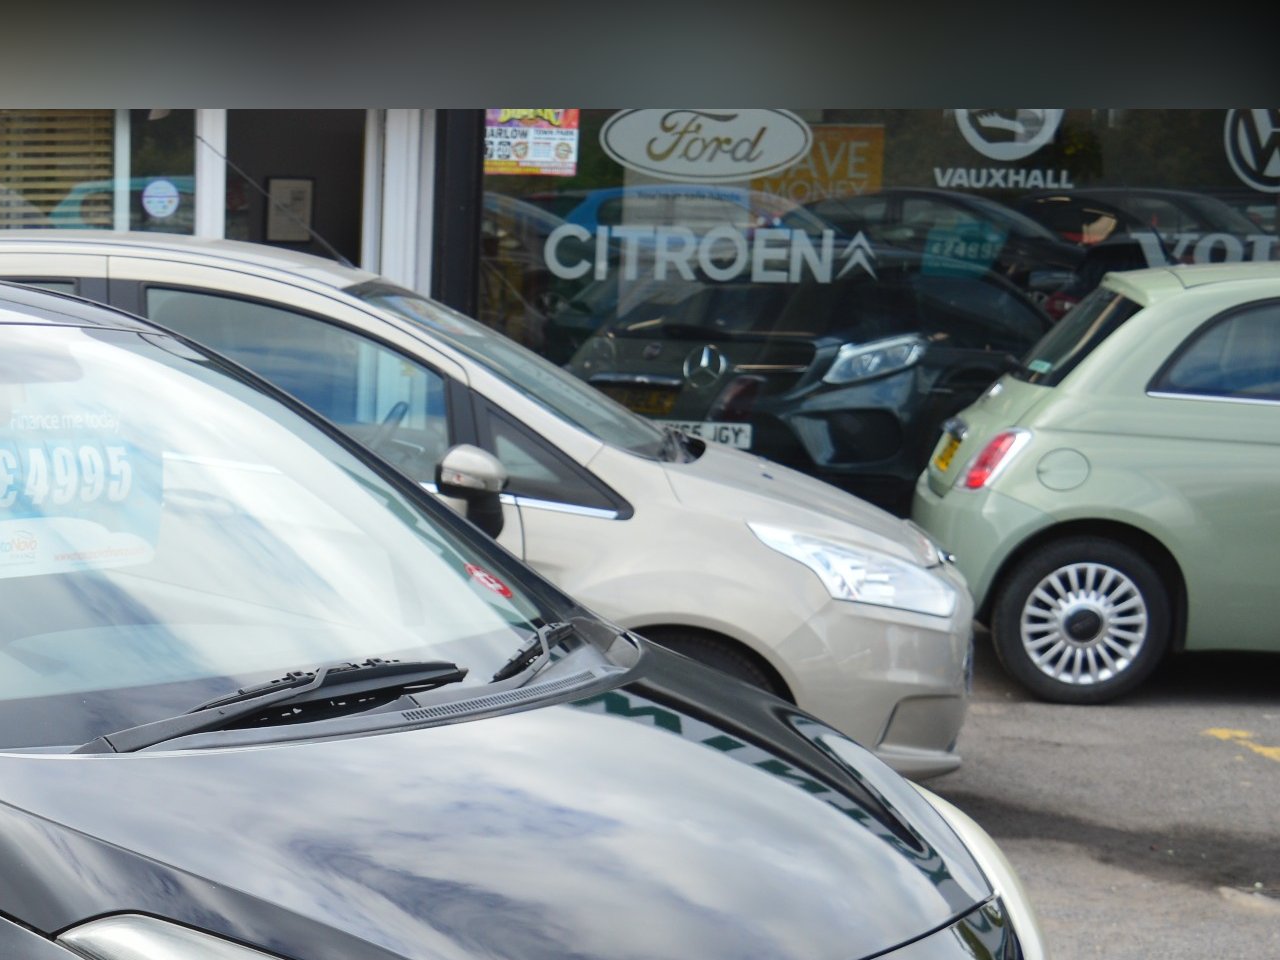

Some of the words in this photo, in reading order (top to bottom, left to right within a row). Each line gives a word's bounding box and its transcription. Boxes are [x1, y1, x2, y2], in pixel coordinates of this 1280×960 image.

[647, 109, 768, 163] Ford
[769, 140, 870, 180] AVE
[933, 167, 1075, 190] VAUXHALL
